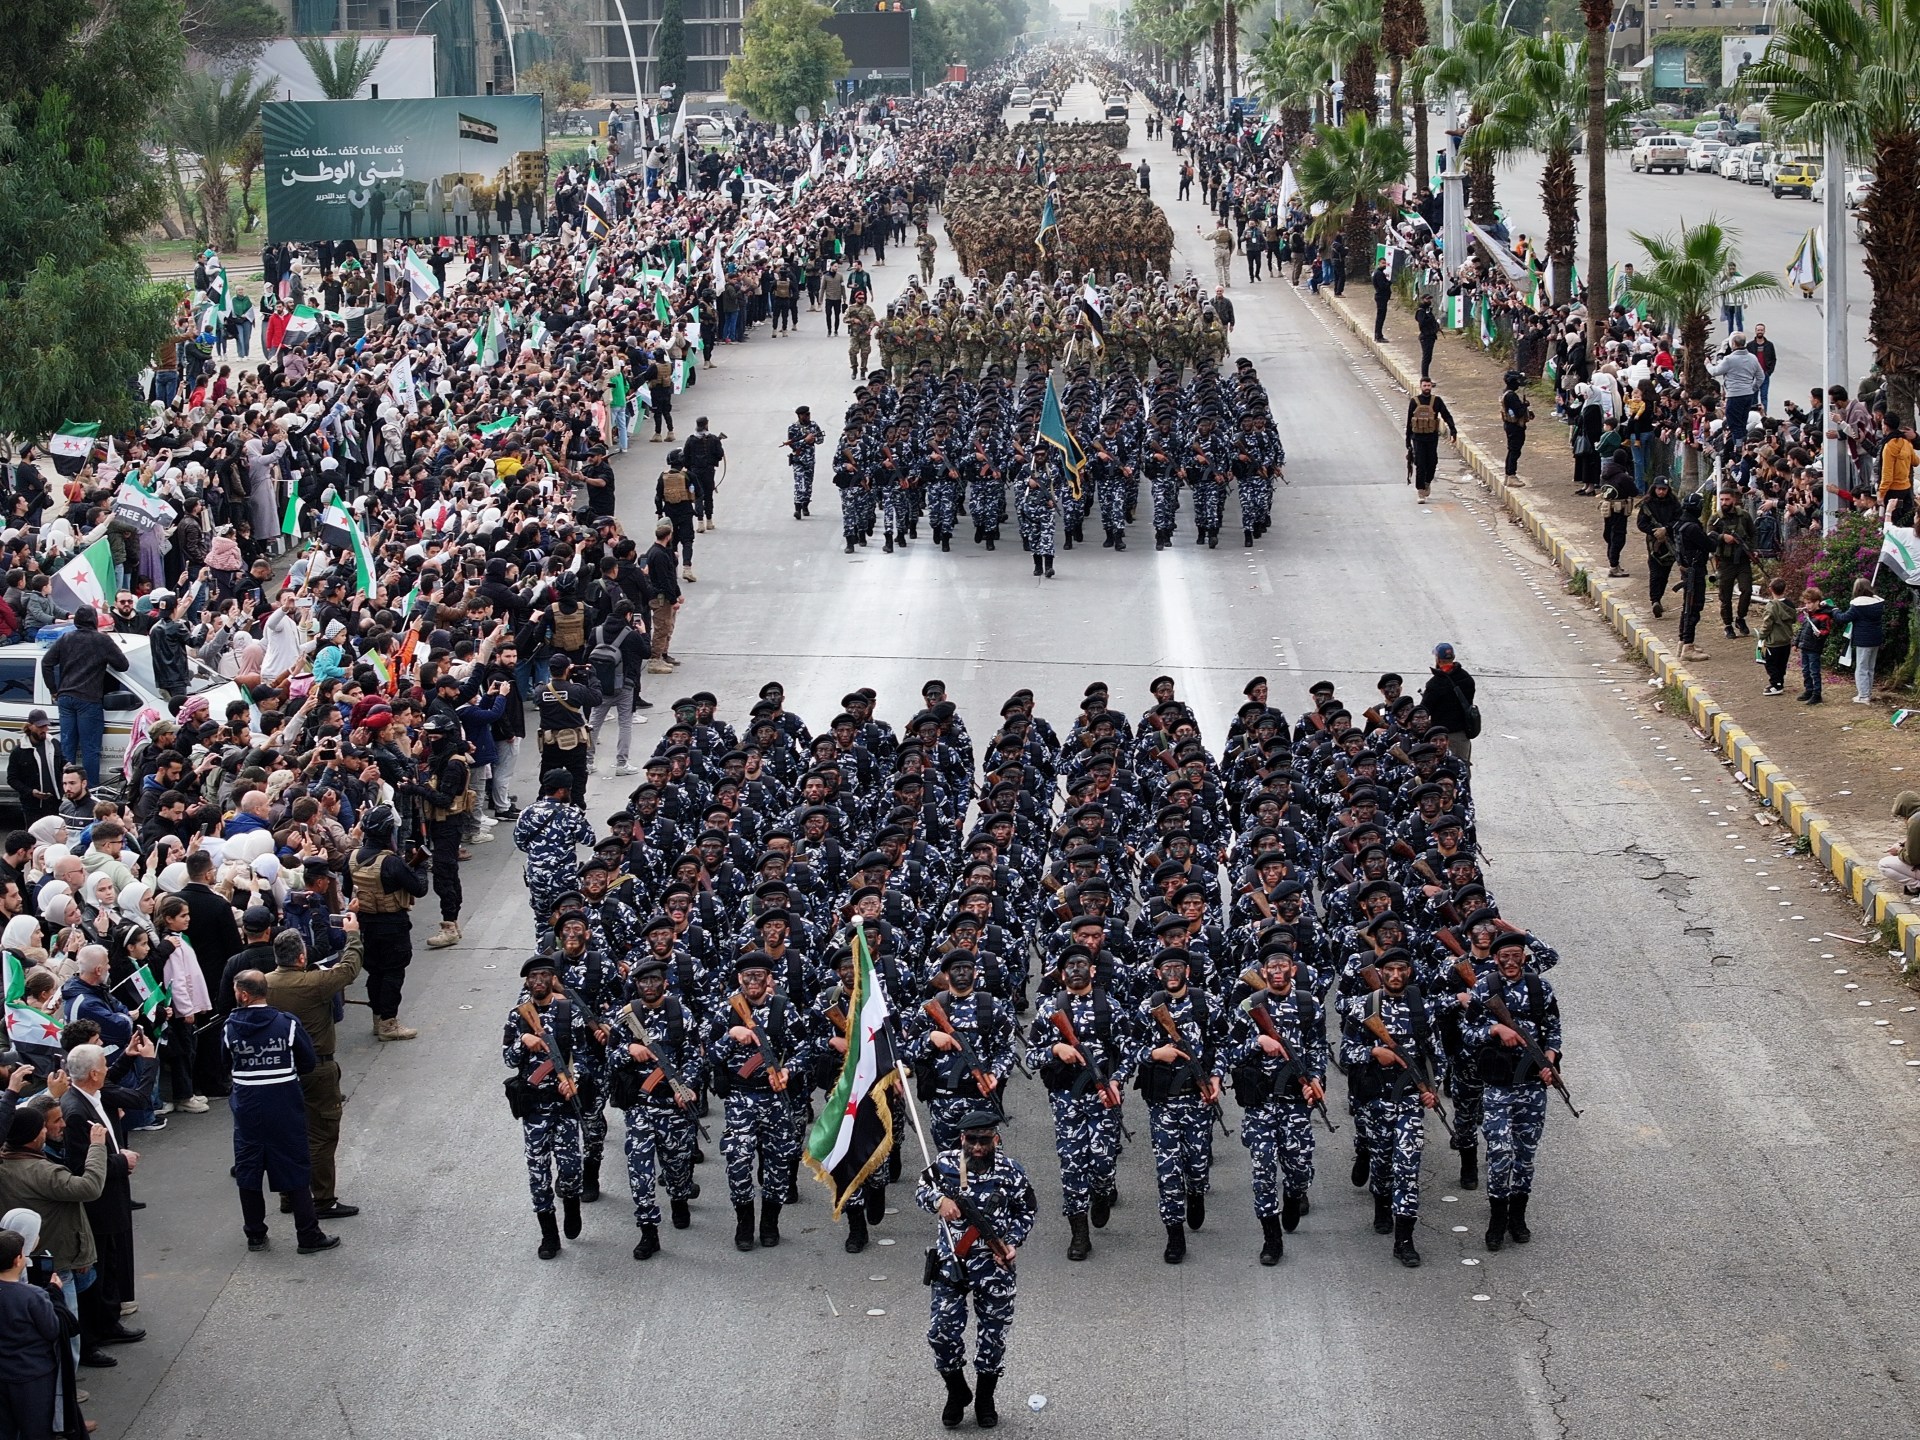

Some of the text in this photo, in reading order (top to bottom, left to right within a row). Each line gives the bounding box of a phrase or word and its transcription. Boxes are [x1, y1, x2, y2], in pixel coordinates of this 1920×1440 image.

[338, 146, 359, 156] كتف
[360, 145, 382, 155] على
[383, 144, 404, 154] كتف
[281, 159, 356, 187] الوطن
[232, 1037, 287, 1057] الشرطة
[241, 1056, 281, 1066] POLICE
